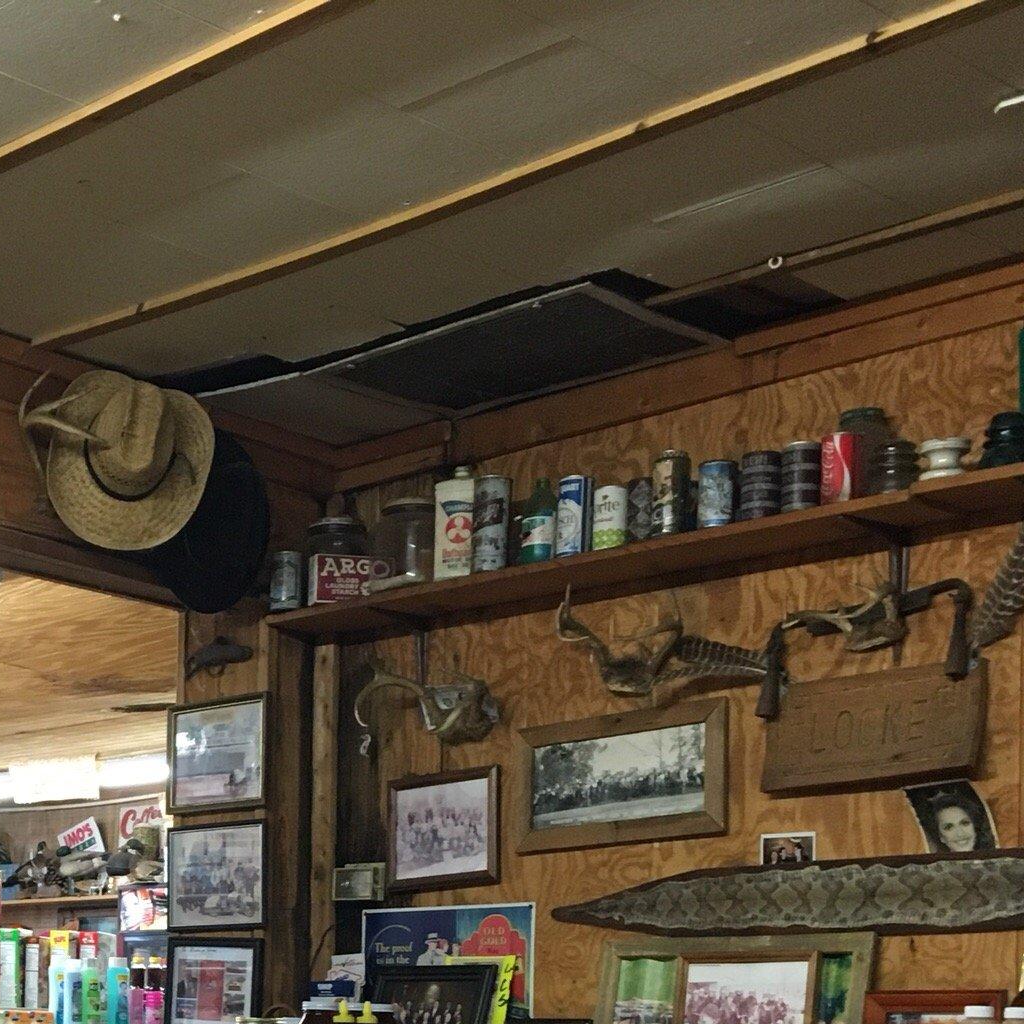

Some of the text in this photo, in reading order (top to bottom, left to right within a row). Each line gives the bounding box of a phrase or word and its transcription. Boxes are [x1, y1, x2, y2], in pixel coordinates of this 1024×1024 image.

[595, 499, 621, 514] rite
[320, 557, 390, 579] ARGO
[376, 942, 391, 953] The
